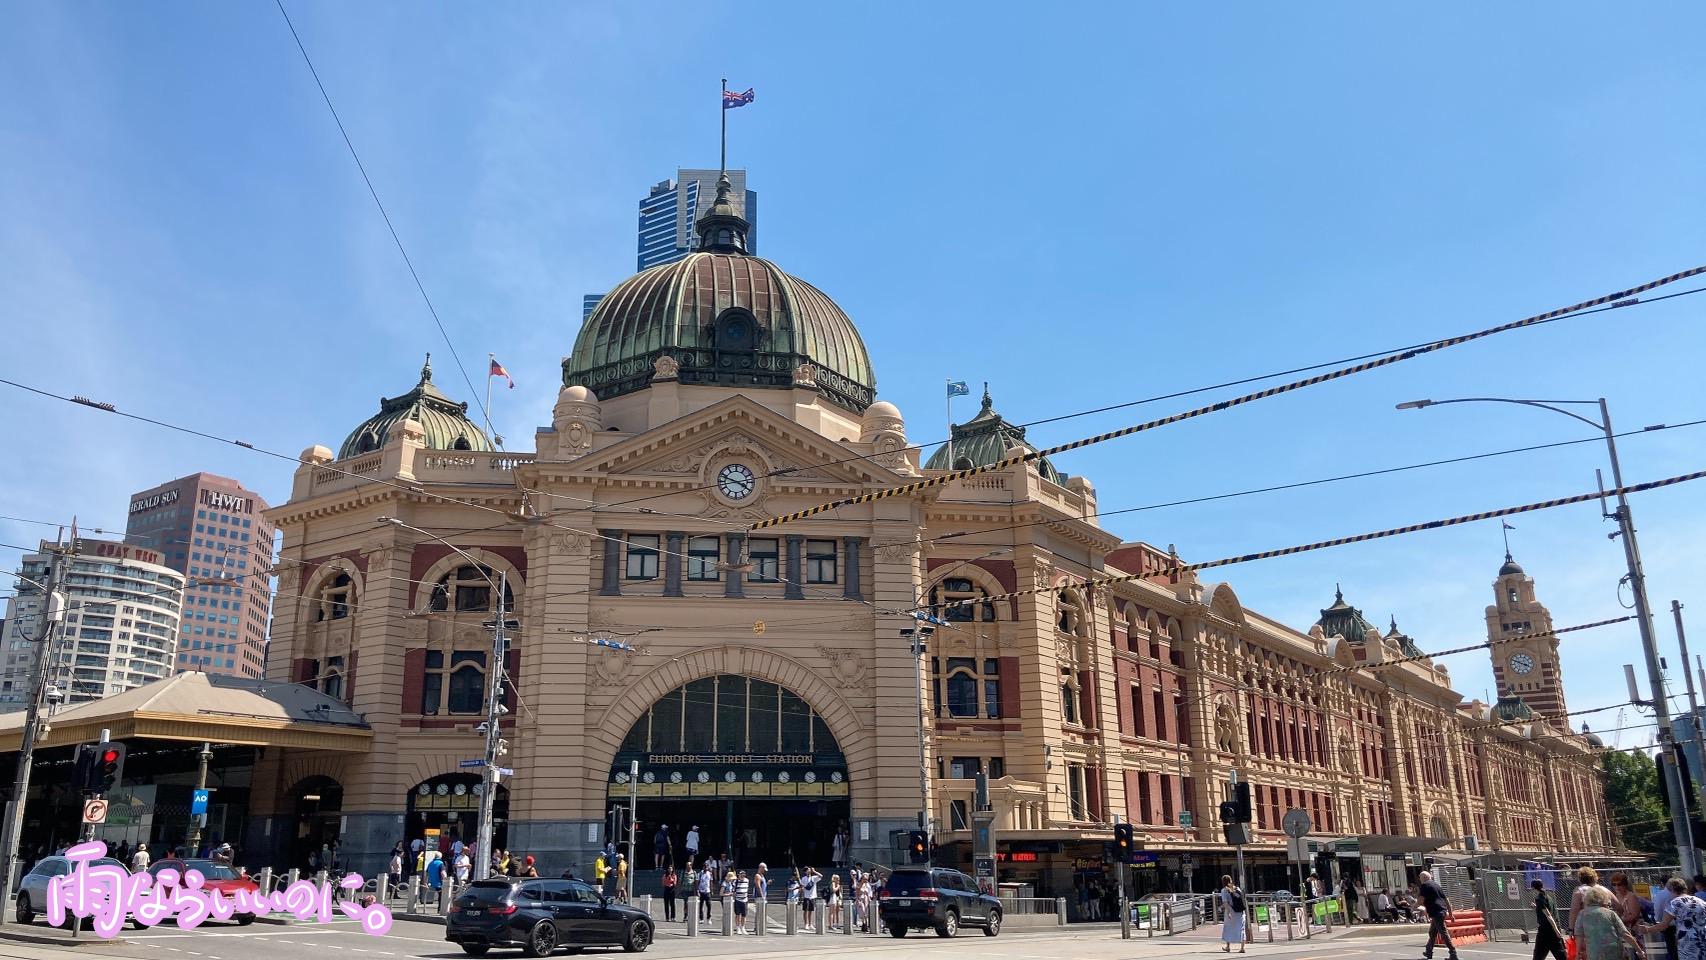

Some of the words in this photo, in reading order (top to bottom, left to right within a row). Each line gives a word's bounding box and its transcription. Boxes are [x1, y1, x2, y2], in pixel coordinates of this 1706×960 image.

[161, 490, 178, 504] SUN
[211, 491, 244, 510] HWT
[649, 755, 701, 764] FLINDERS
[714, 755, 753, 764] STREET
[767, 755, 813, 764] STATION
